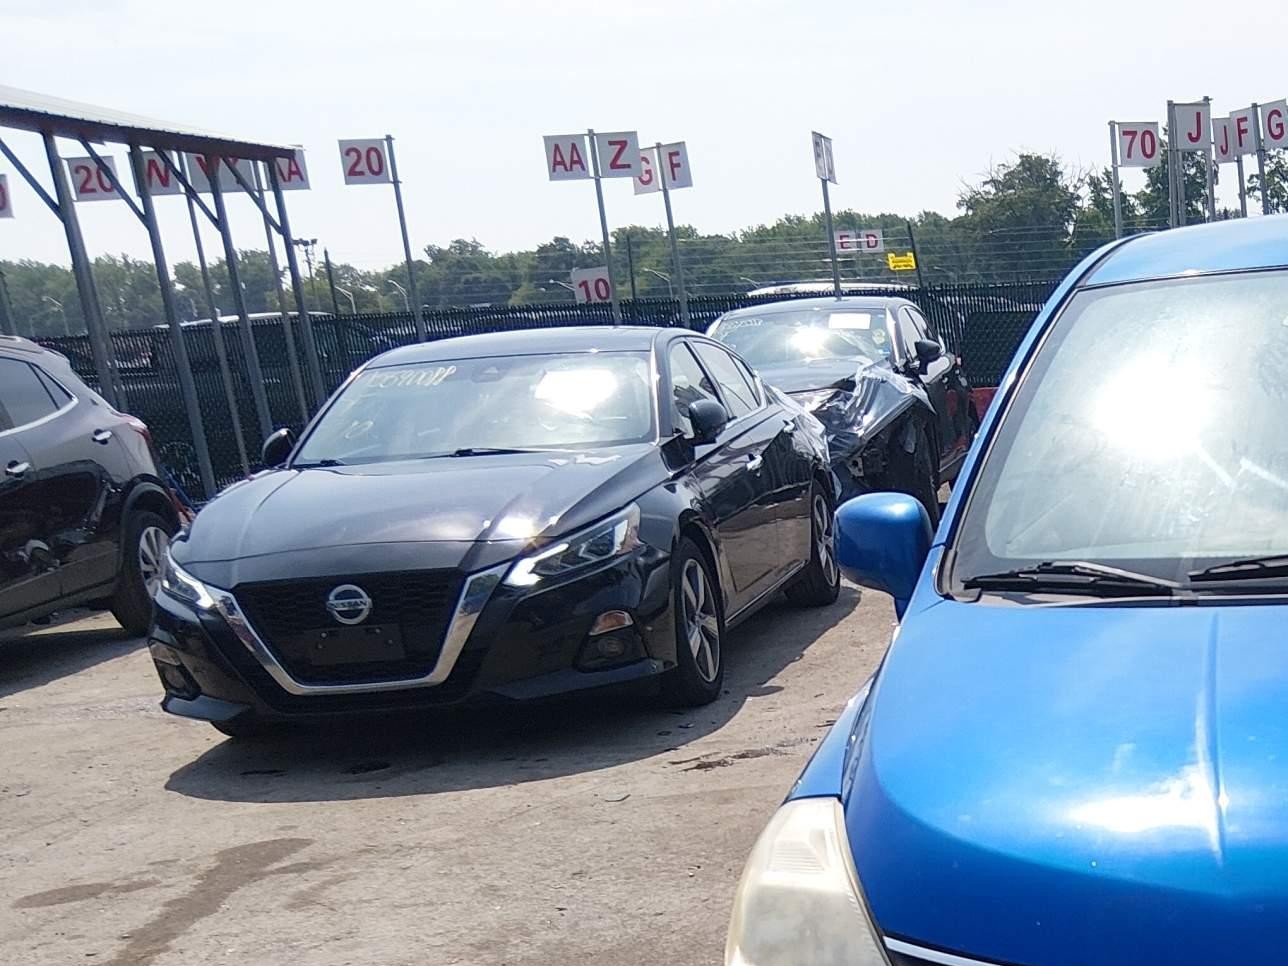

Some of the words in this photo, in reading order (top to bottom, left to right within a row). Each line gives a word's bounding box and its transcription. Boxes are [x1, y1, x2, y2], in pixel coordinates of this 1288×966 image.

[1187, 112, 1203, 144] J
[1236, 116, 1248, 147] F
[1266, 107, 1286, 140] G
[608, 139, 632, 170] Z
[1121, 129, 1157, 160] 70
[1219, 127, 1229, 156] J
[344, 146, 384, 177] 20
[553, 142, 586, 172] AA
[638, 157, 654, 186] G
[669, 150, 682, 181] F
[74, 165, 114, 194] 20
[146, 159, 170, 188] N
[839, 234, 853, 250] E
[864, 233, 879, 250] D
[578, 278, 612, 304] 10
